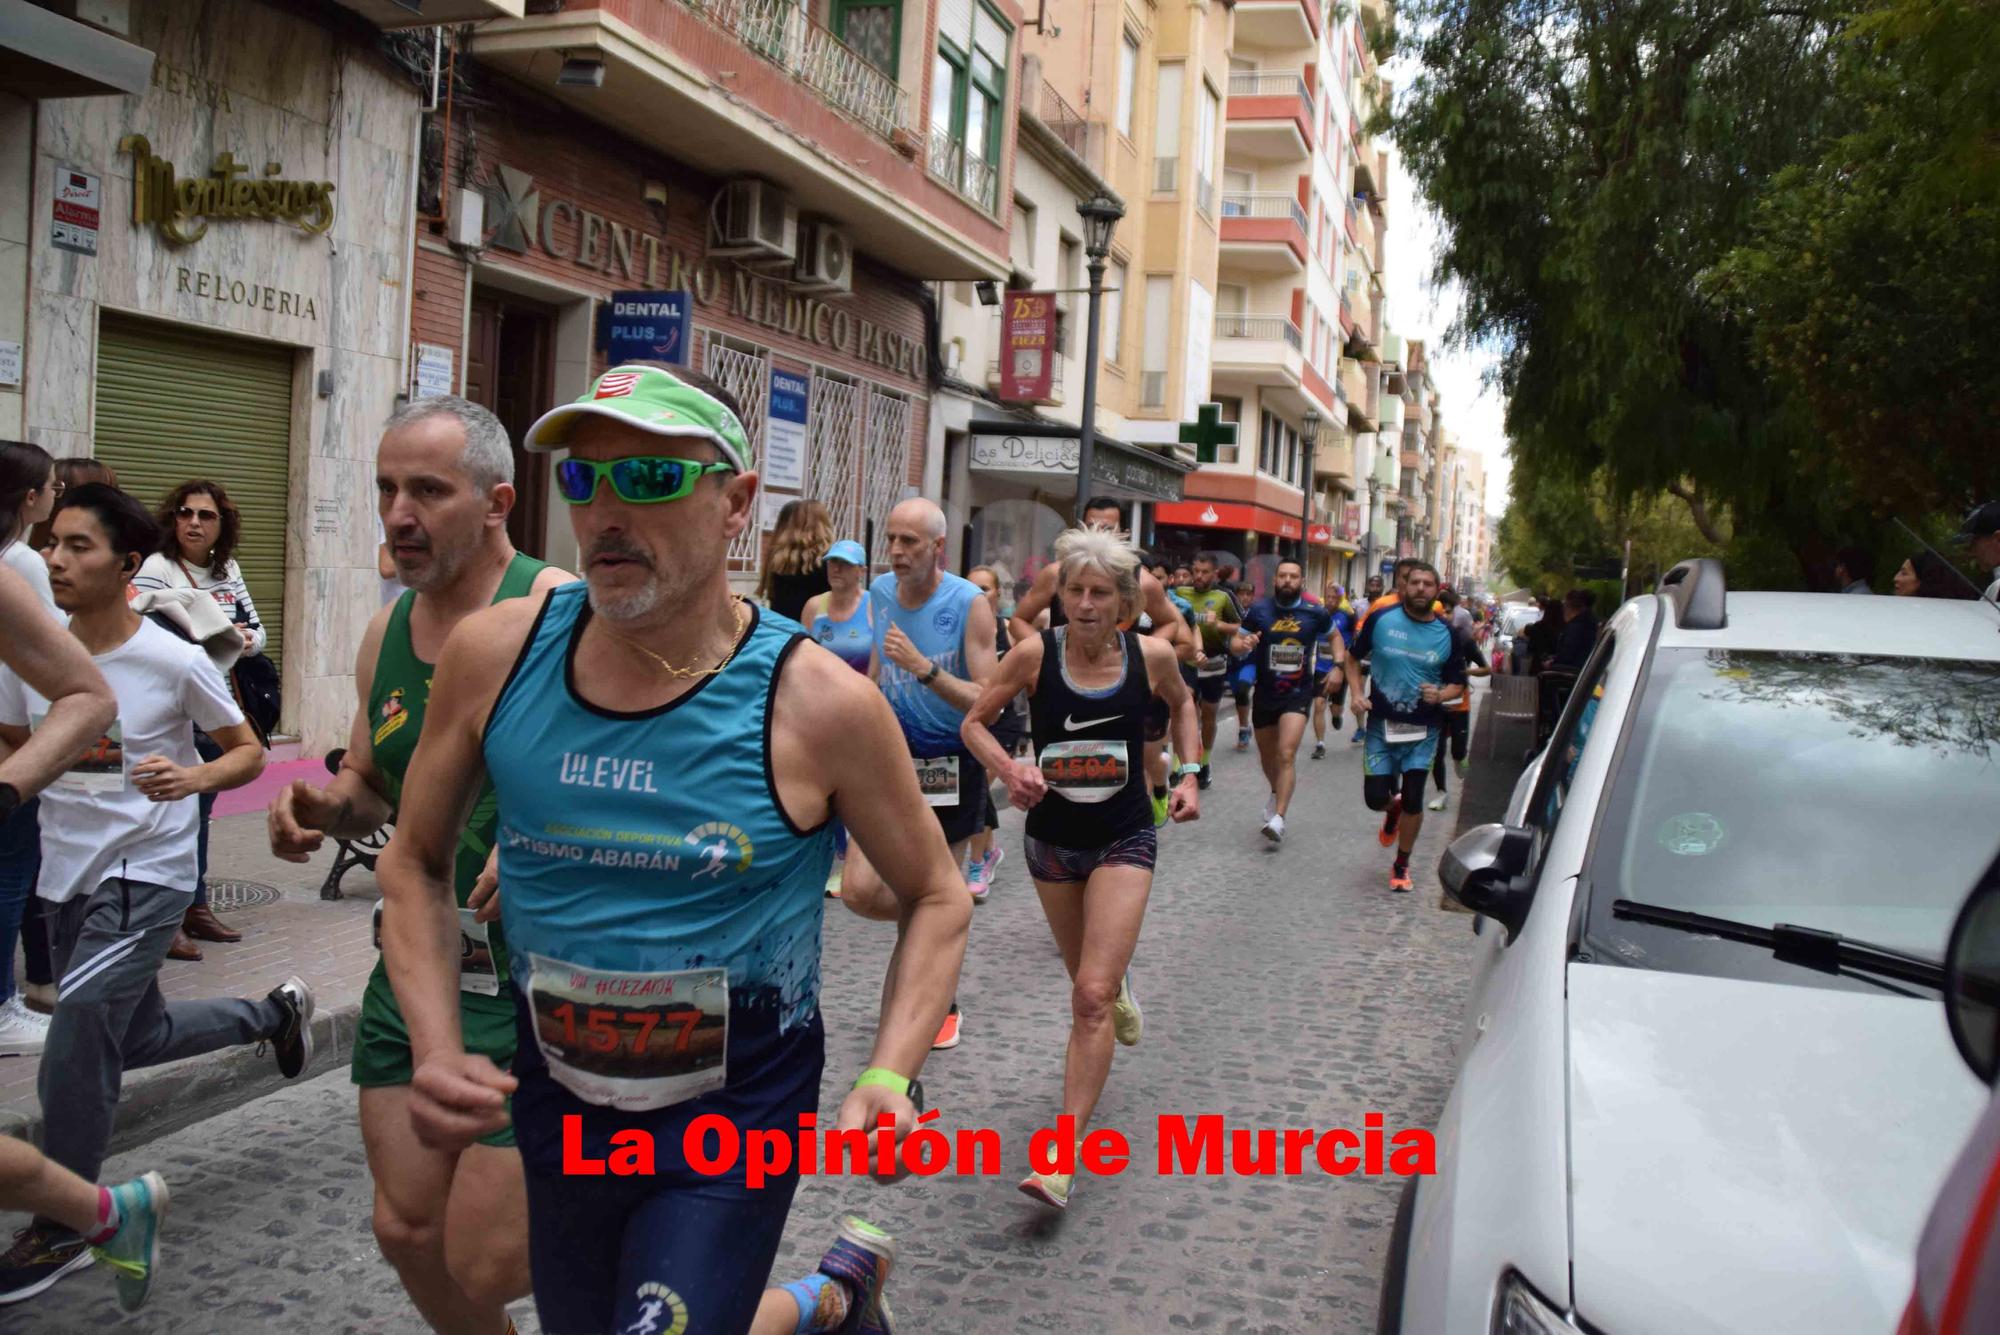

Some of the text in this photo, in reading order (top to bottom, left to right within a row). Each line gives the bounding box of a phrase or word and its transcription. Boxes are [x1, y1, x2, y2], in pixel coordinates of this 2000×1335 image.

[117, 134, 335, 246] Montesinos
[176, 267, 317, 321] RELOJERIA
[541, 201, 721, 307] CENTRO
[857, 319, 927, 380] PASEO
[614, 302, 681, 317] DENTAL
[611, 325, 655, 340] PLUS
[774, 376, 806, 395] DENTAL
[1002, 436, 1080, 461] Delicias
[1051, 757, 1118, 777] 1504
[590, 848, 680, 871] ABARÁN
[553, 1002, 703, 1054] 1577
